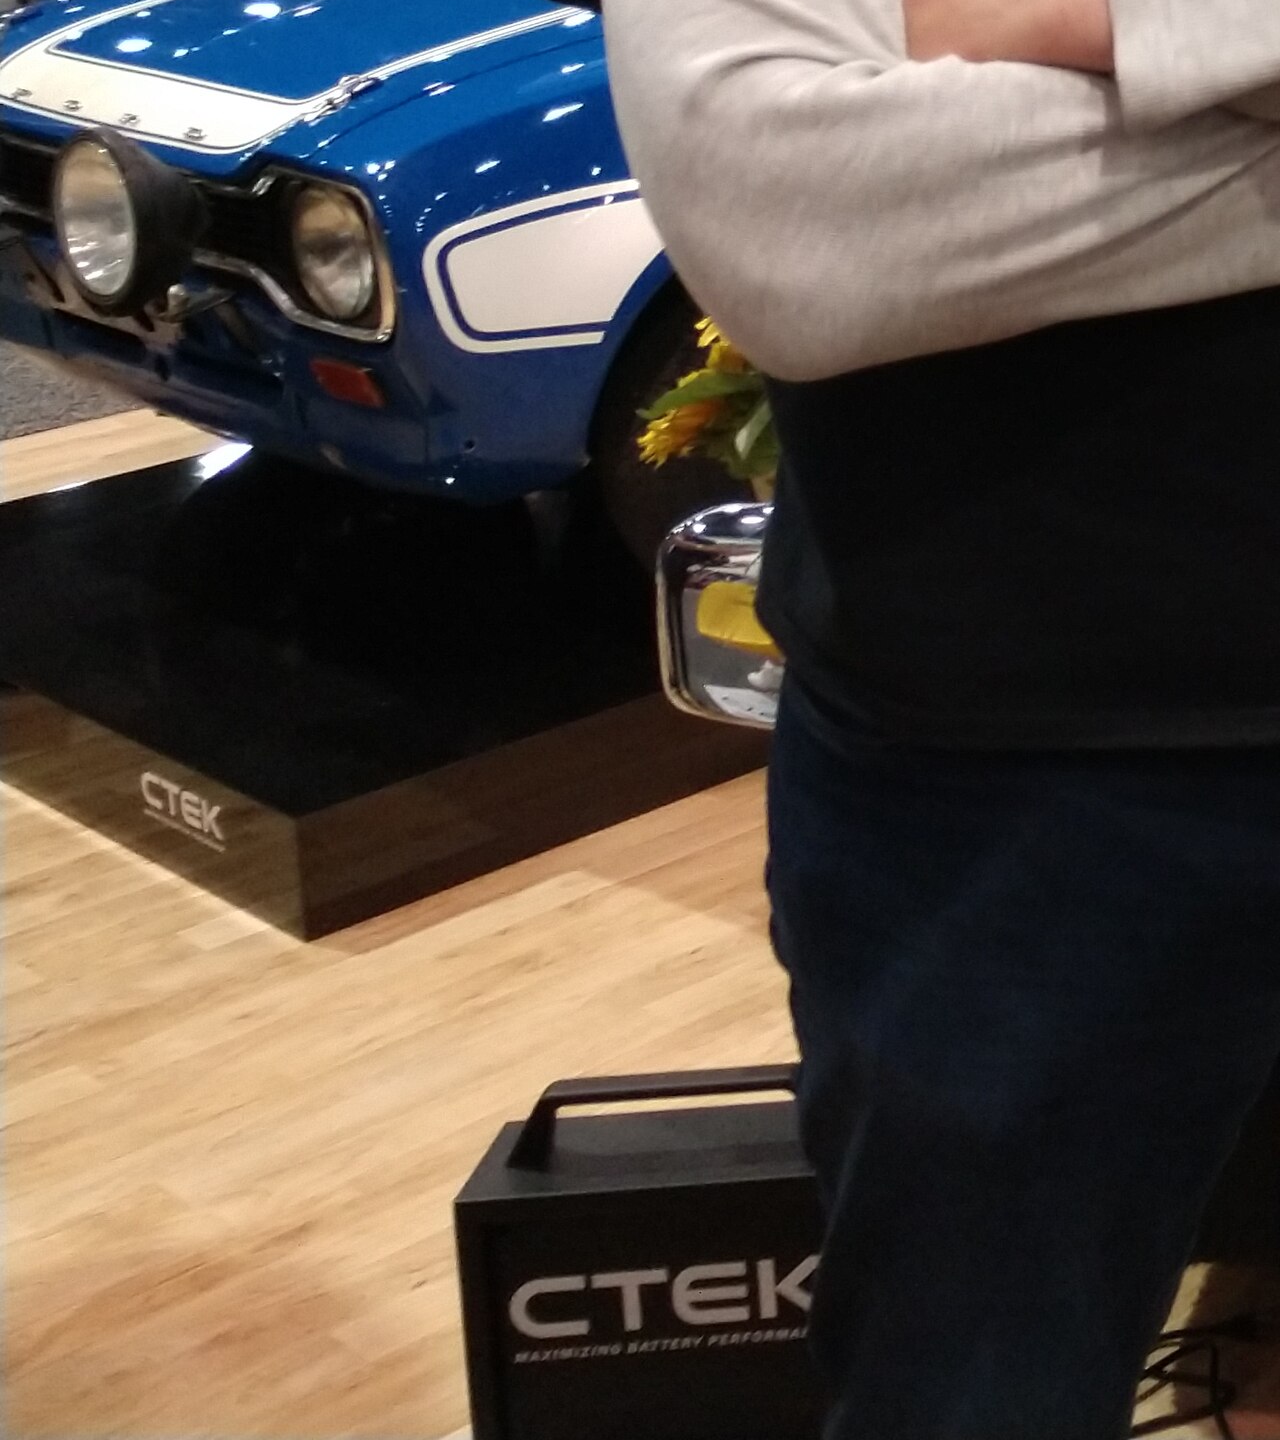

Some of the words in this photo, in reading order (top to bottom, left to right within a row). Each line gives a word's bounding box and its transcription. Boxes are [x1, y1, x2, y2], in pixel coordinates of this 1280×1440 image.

[140, 771, 225, 841] CTEK
[508, 1254, 822, 1340] CTEK
[513, 1345, 622, 1365] MAXIMIZING
[626, 1336, 704, 1355] BATTERY
